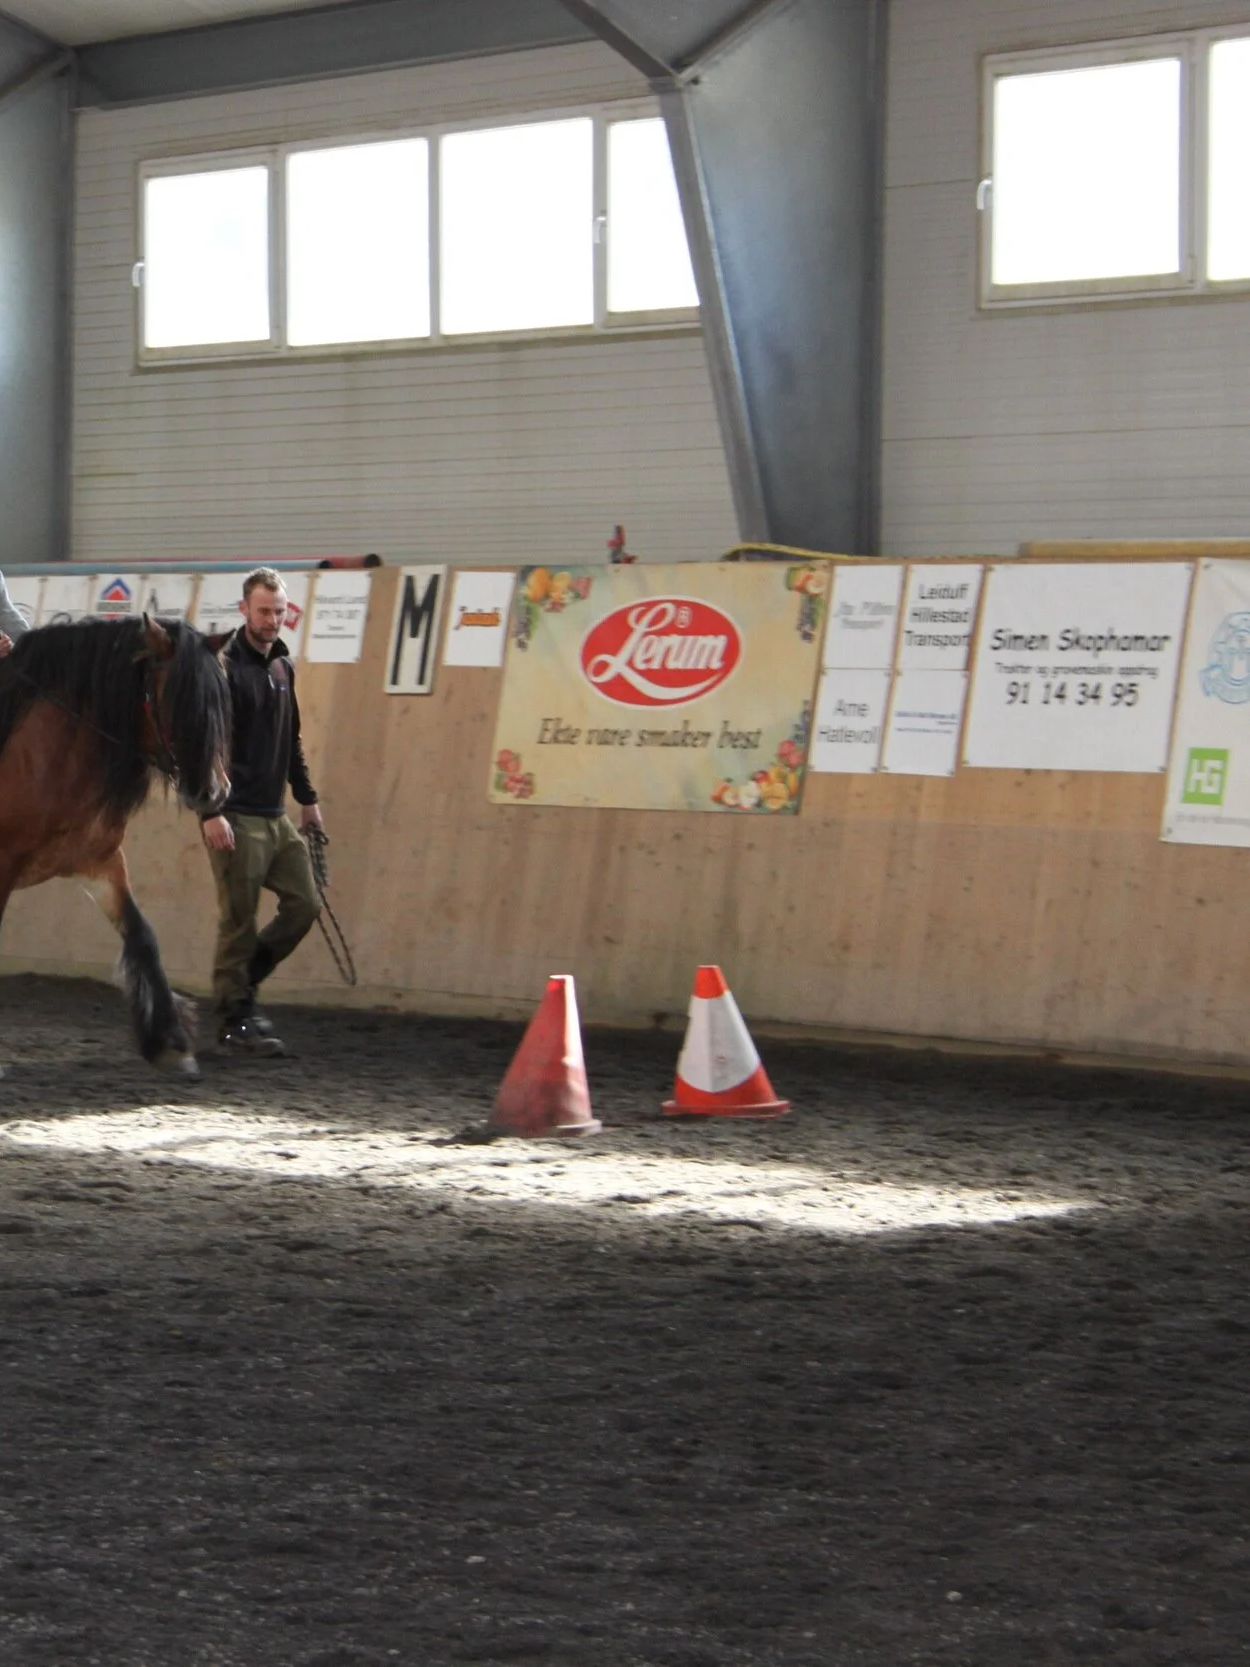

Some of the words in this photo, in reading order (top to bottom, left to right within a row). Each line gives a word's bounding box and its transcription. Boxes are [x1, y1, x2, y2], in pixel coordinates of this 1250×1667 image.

[910, 606, 971, 624] Hillestad
[390, 573, 442, 687] M
[904, 629, 970, 649] Transport
[989, 627, 1049, 651] Simen
[586, 602, 729, 701] Lerum
[1005, 681, 1030, 706] 91
[1041, 681, 1068, 706] 14
[1075, 681, 1103, 707] 34
[1110, 682, 1139, 707] 95
[536, 717, 583, 746] Ekte
[634, 719, 712, 749] smaker
[715, 719, 763, 750] best
